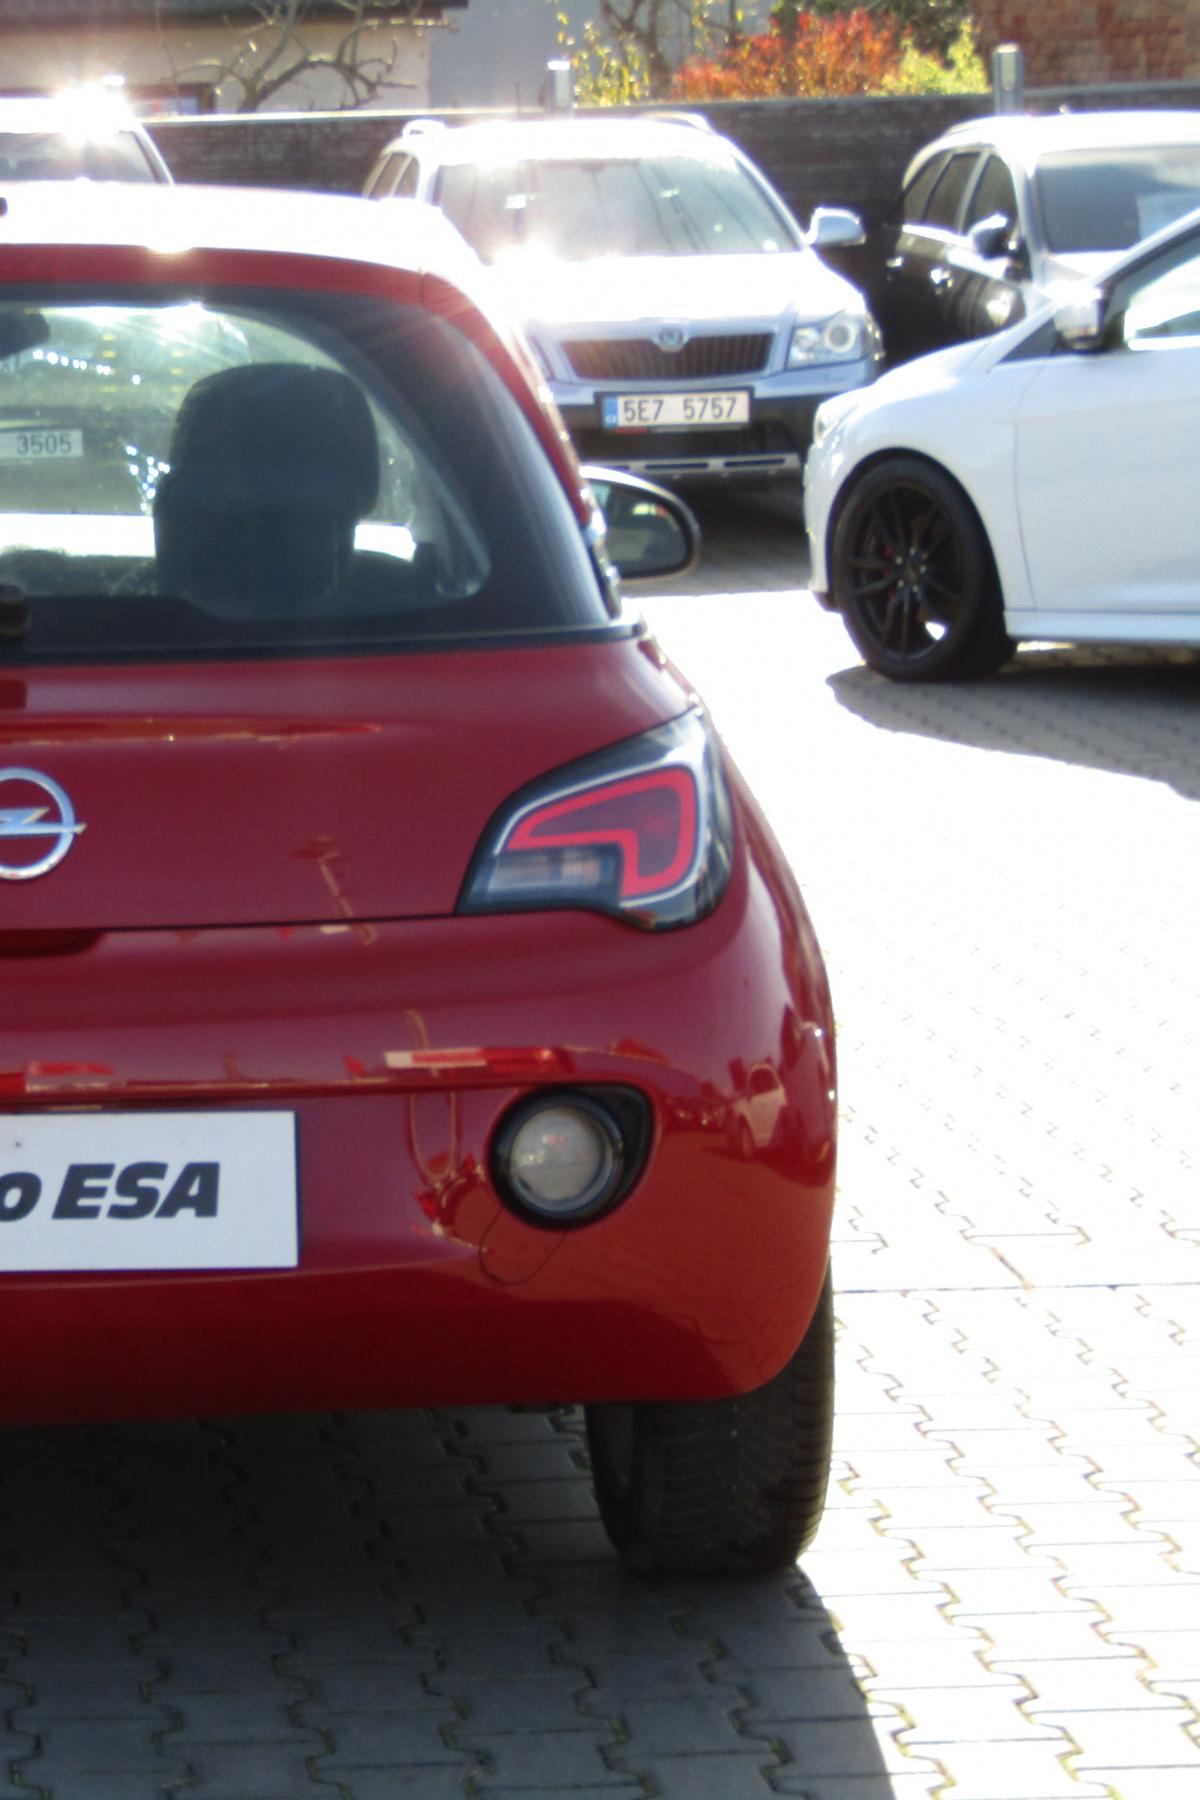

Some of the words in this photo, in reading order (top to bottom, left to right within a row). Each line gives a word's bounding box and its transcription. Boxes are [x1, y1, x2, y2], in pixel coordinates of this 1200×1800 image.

[623, 399, 664, 421] 5E7
[682, 396, 737, 419] 5757
[16, 433, 72, 454] 3505
[51, 1161, 221, 1220] ESA
